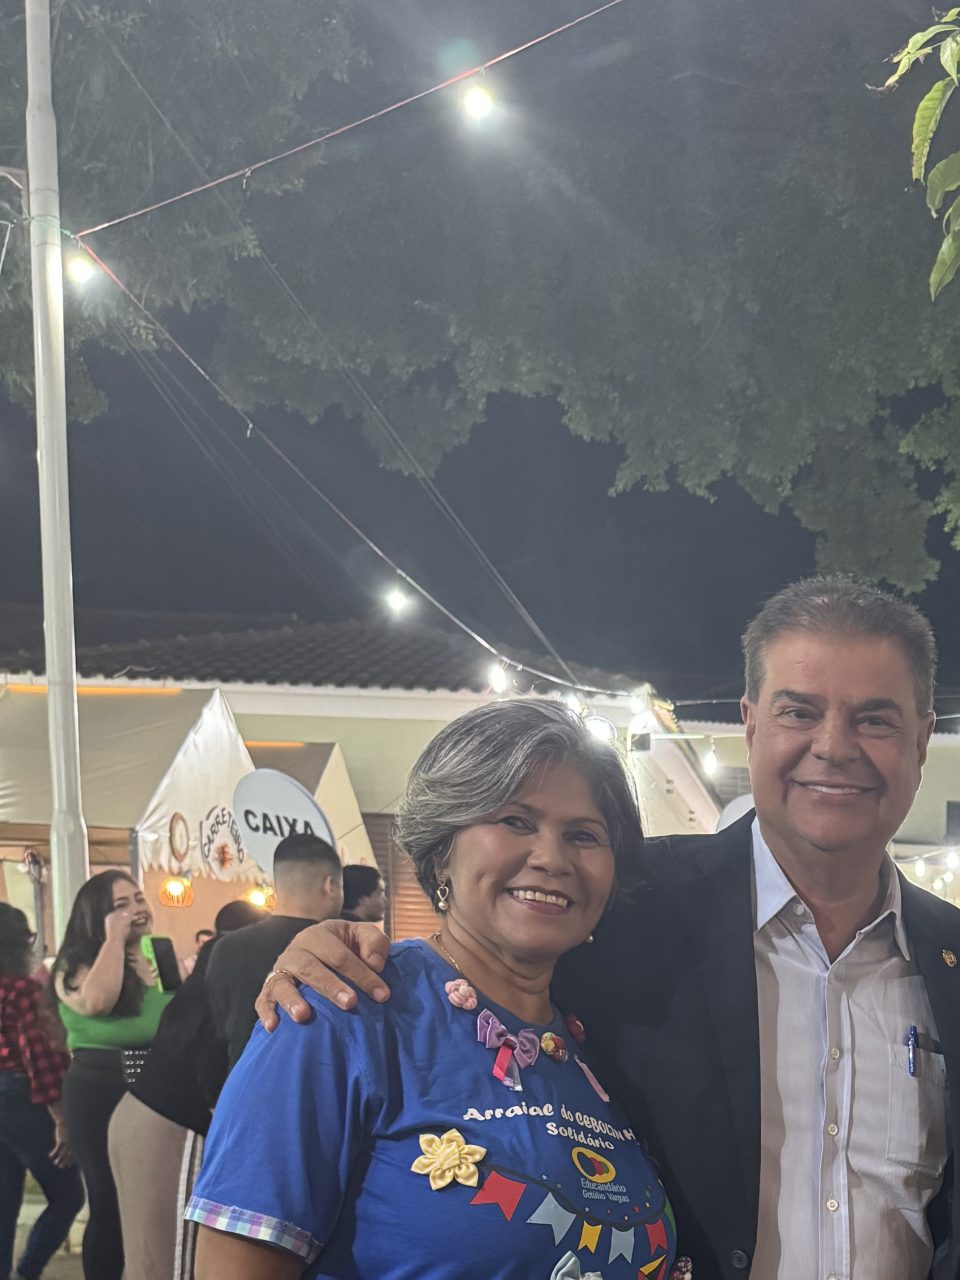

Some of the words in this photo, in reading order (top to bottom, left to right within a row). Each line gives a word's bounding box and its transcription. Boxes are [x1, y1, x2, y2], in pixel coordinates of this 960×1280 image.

[244, 809, 315, 837] CAIXA
[463, 1101, 554, 1121] Arraial
[561, 1104, 574, 1122] do
[575, 1112, 639, 1144] CEBOLINH
[545, 1122, 614, 1150] Solidário
[581, 1178, 626, 1193] Educandário
[606, 1192, 630, 1203] Vargas
